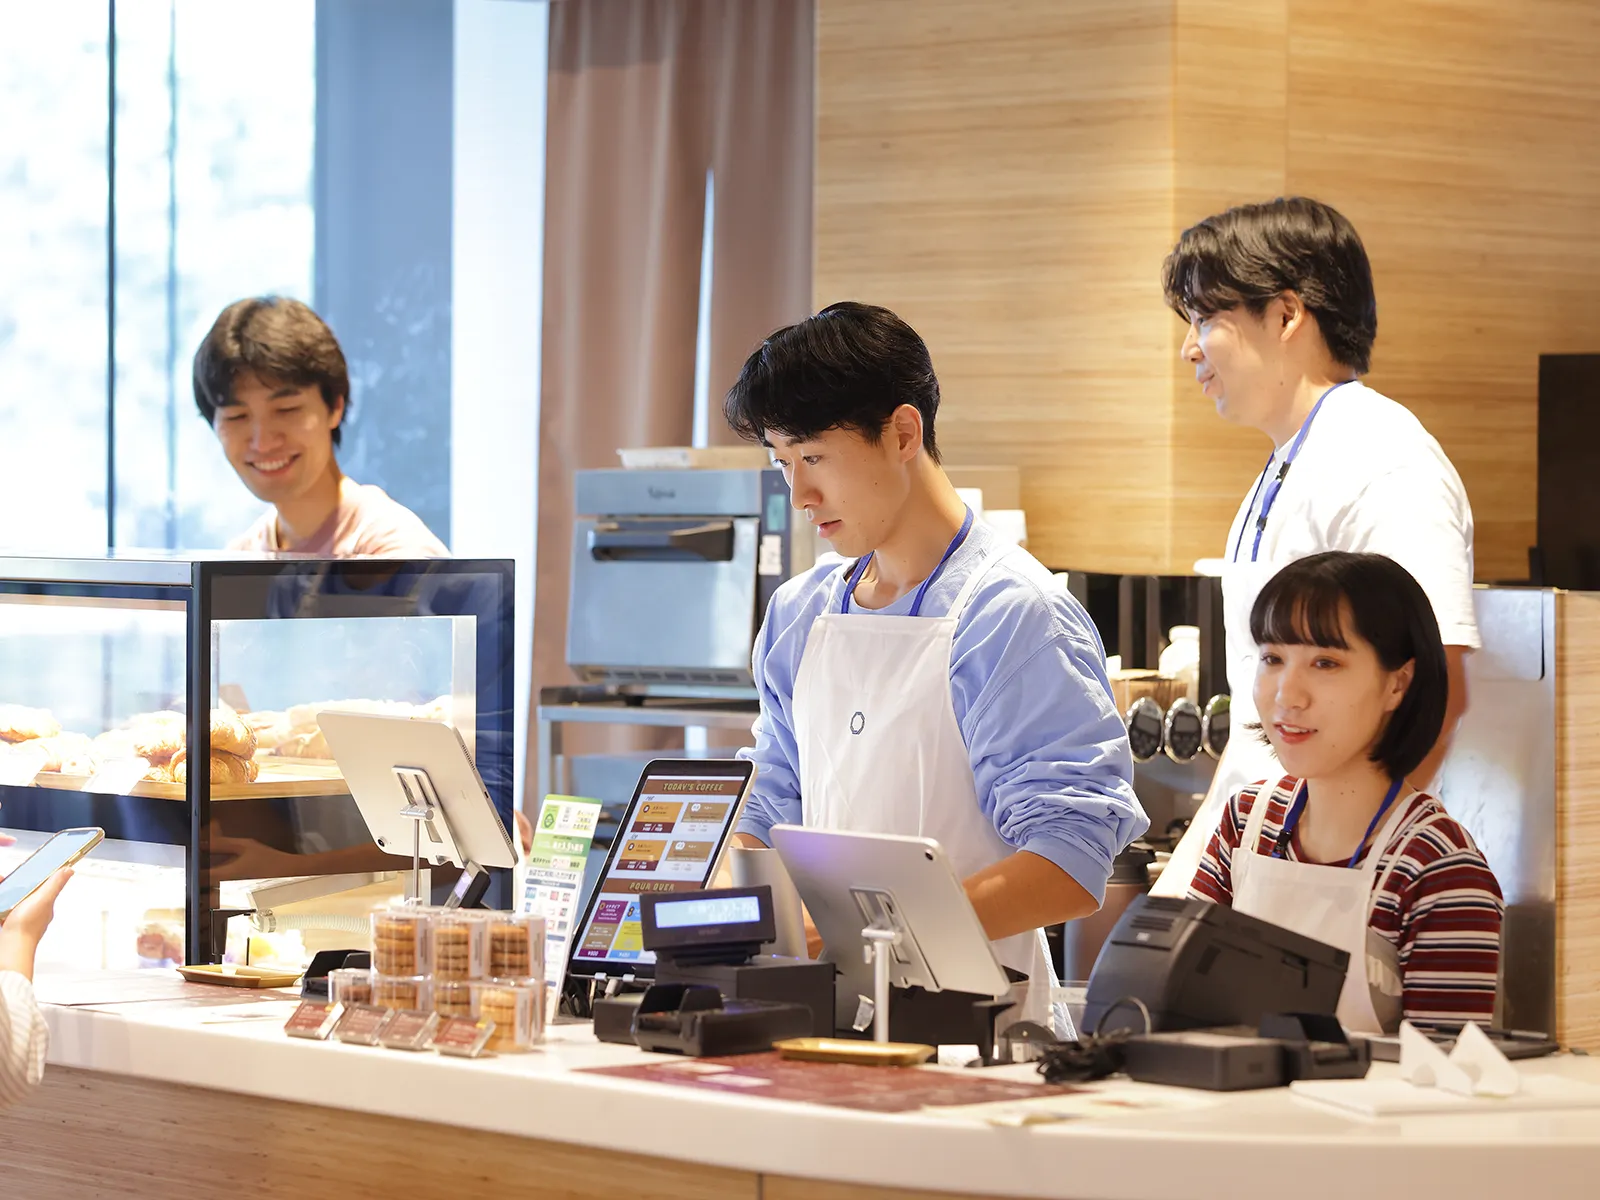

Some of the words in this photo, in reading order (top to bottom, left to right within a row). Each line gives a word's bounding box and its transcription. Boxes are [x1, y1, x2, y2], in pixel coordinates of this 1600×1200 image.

[663, 783, 695, 791] TODAY'S
[695, 783, 724, 791] COFFEE
[629, 882, 651, 891] POUR
[652, 883, 675, 892] OVER
